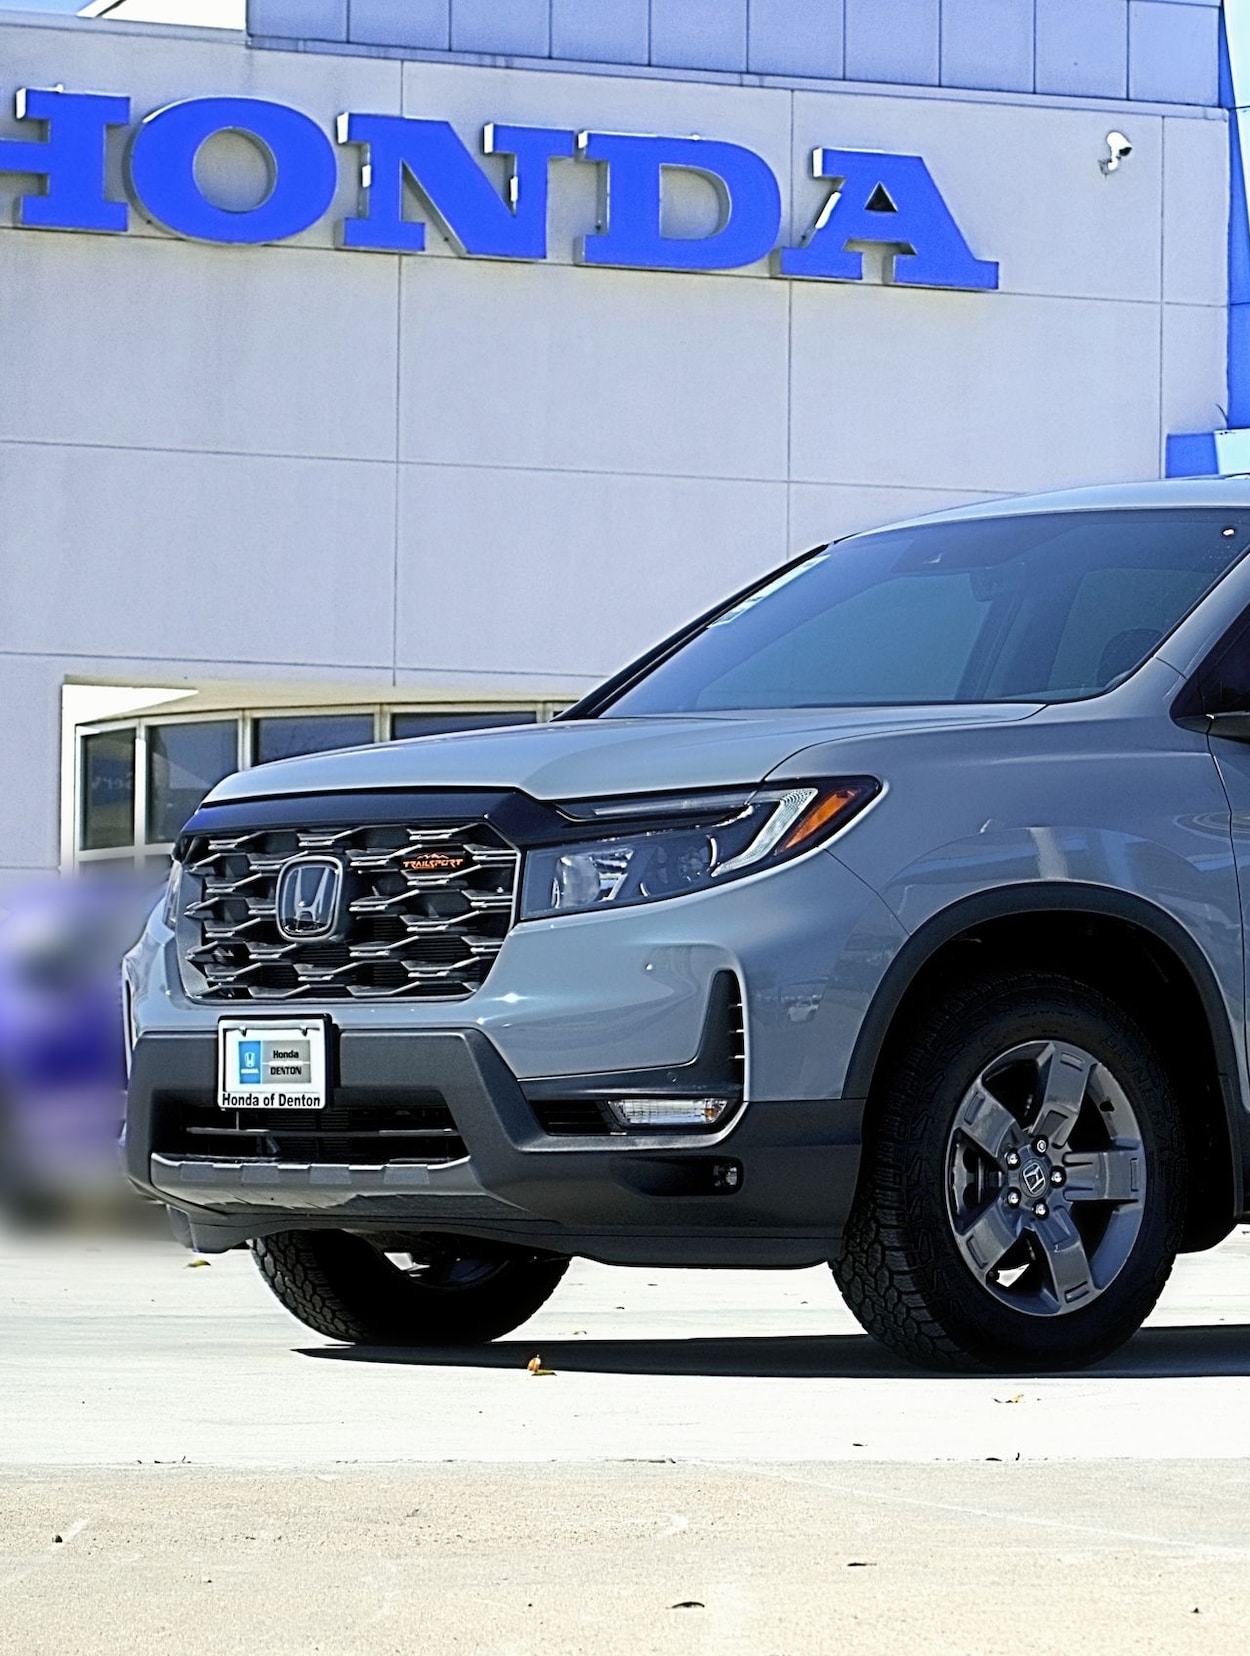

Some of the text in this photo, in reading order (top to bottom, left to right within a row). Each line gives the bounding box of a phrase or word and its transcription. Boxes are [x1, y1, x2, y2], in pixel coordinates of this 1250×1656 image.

[0, 84, 1000, 290] HONDA
[403, 859, 464, 869] TRAILSPORT
[272, 1050, 299, 1059] Honda
[270, 1066, 302, 1075] DENTON
[222, 1093, 320, 1107] Honda of Denton
